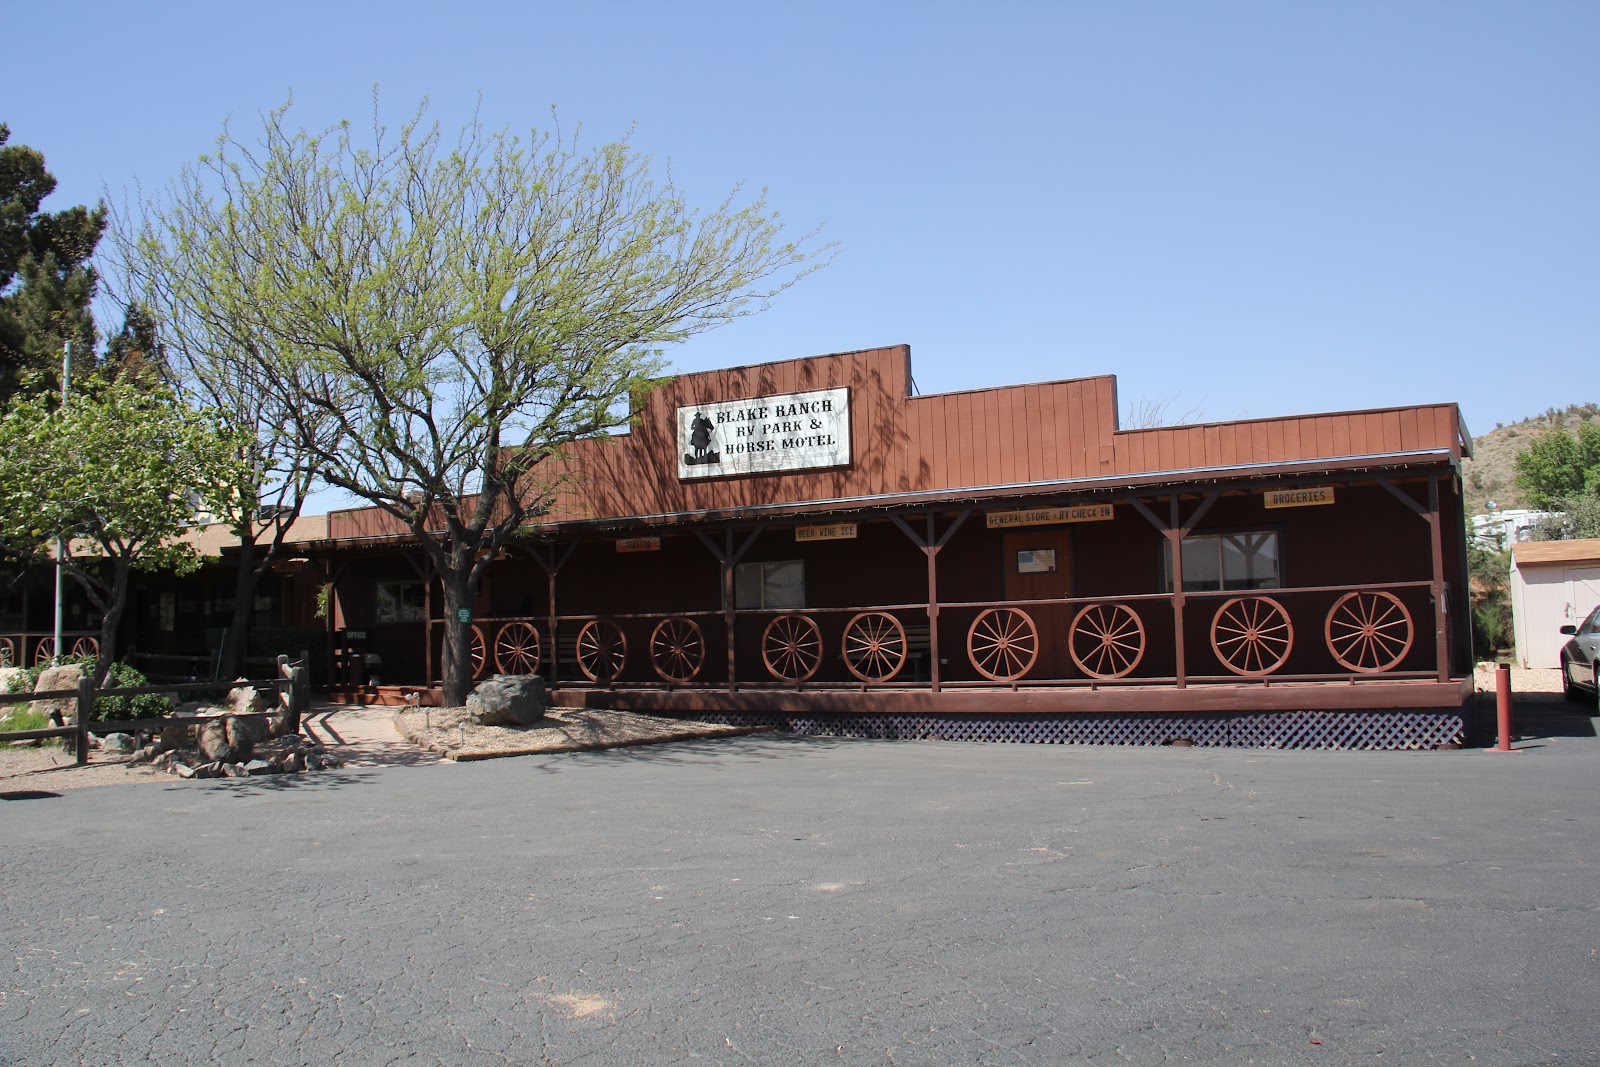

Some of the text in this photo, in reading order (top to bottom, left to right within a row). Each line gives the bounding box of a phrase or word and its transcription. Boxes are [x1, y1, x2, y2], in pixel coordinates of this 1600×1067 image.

[716, 399, 833, 424] BLAKE RANCH
[736, 418, 822, 438] RV PARK &
[725, 434, 836, 455] HORSE MOTEL
[1273, 491, 1326, 504] GROCERIES
[989, 507, 1111, 525] GENERAL STORE RV CHECK IN
[798, 526, 854, 538] BEER WINE ICE
[346, 631, 367, 639] OFFICE
